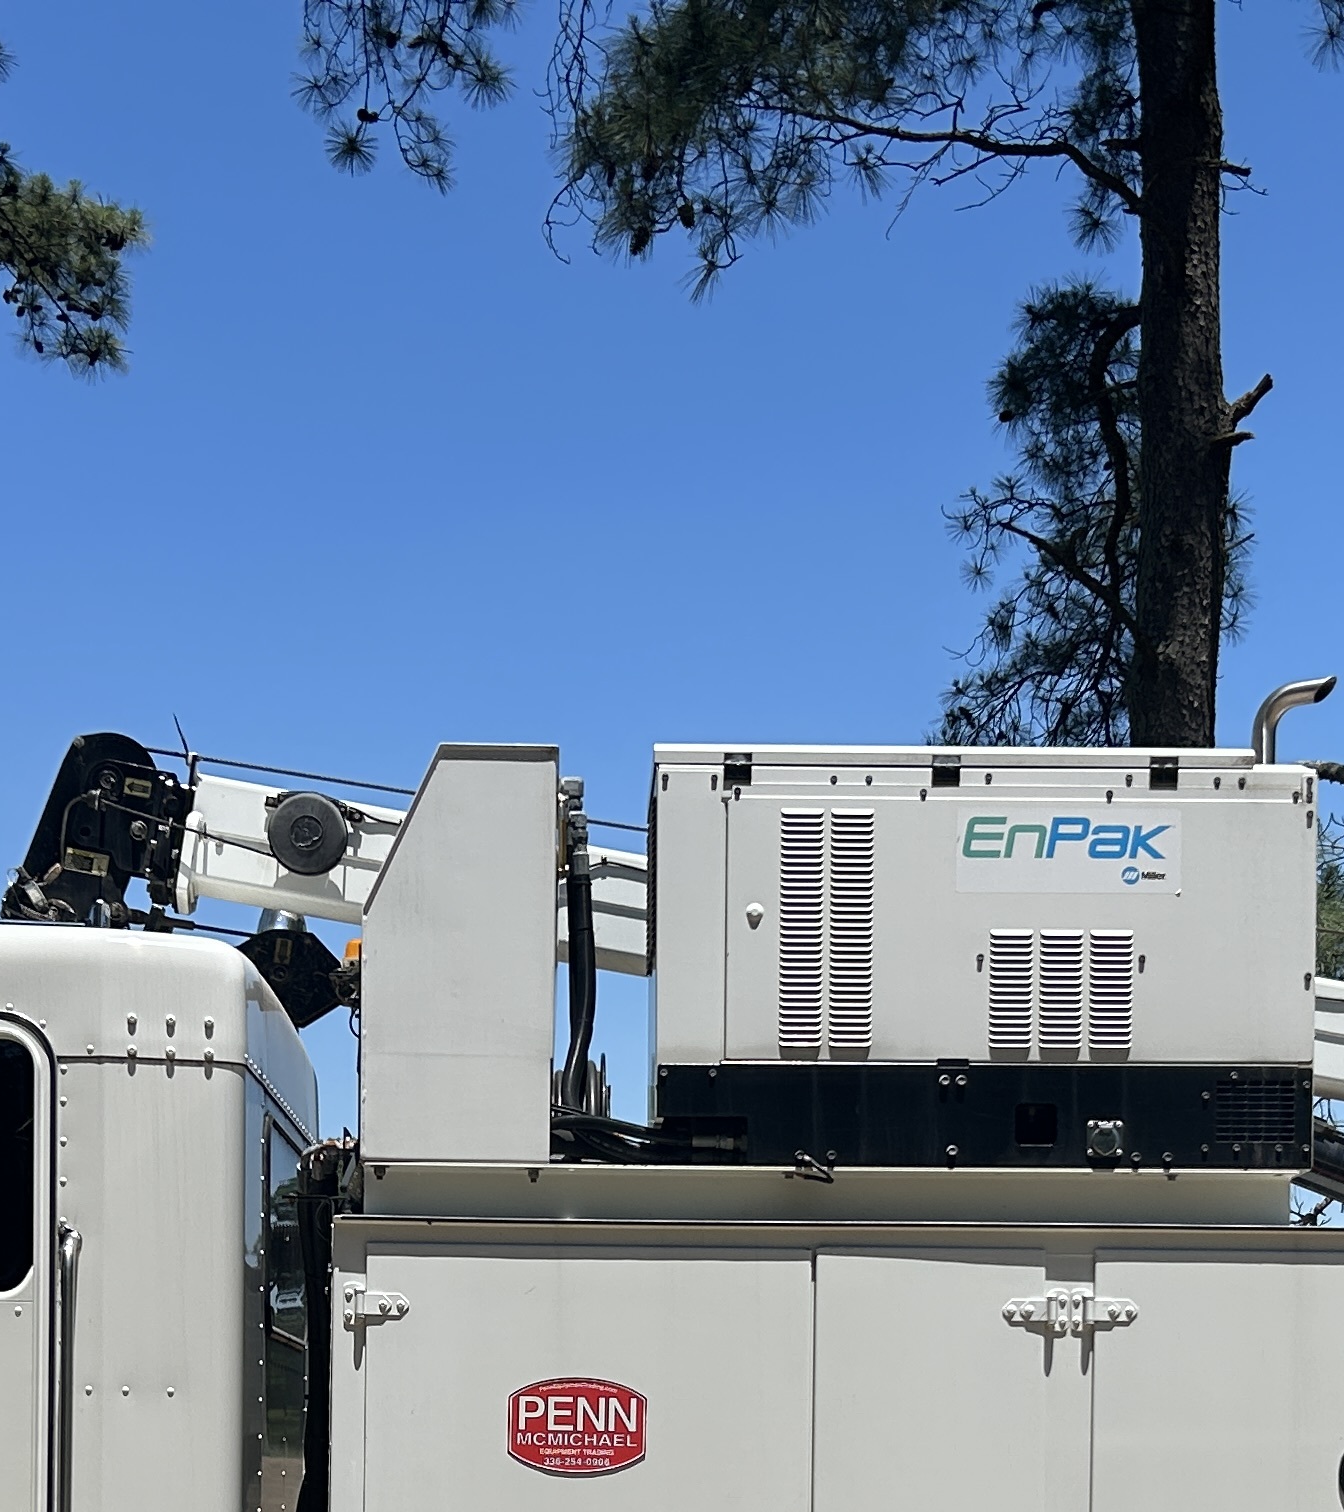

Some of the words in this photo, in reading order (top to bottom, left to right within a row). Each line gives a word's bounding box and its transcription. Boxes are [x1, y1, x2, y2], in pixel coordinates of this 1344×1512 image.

[962, 816, 1172, 859] EnPak
[518, 1395, 637, 1432] PENN
[516, 1432, 638, 1447] MCMICHAEL
[539, 1448, 581, 1456] EQUIPMENT
